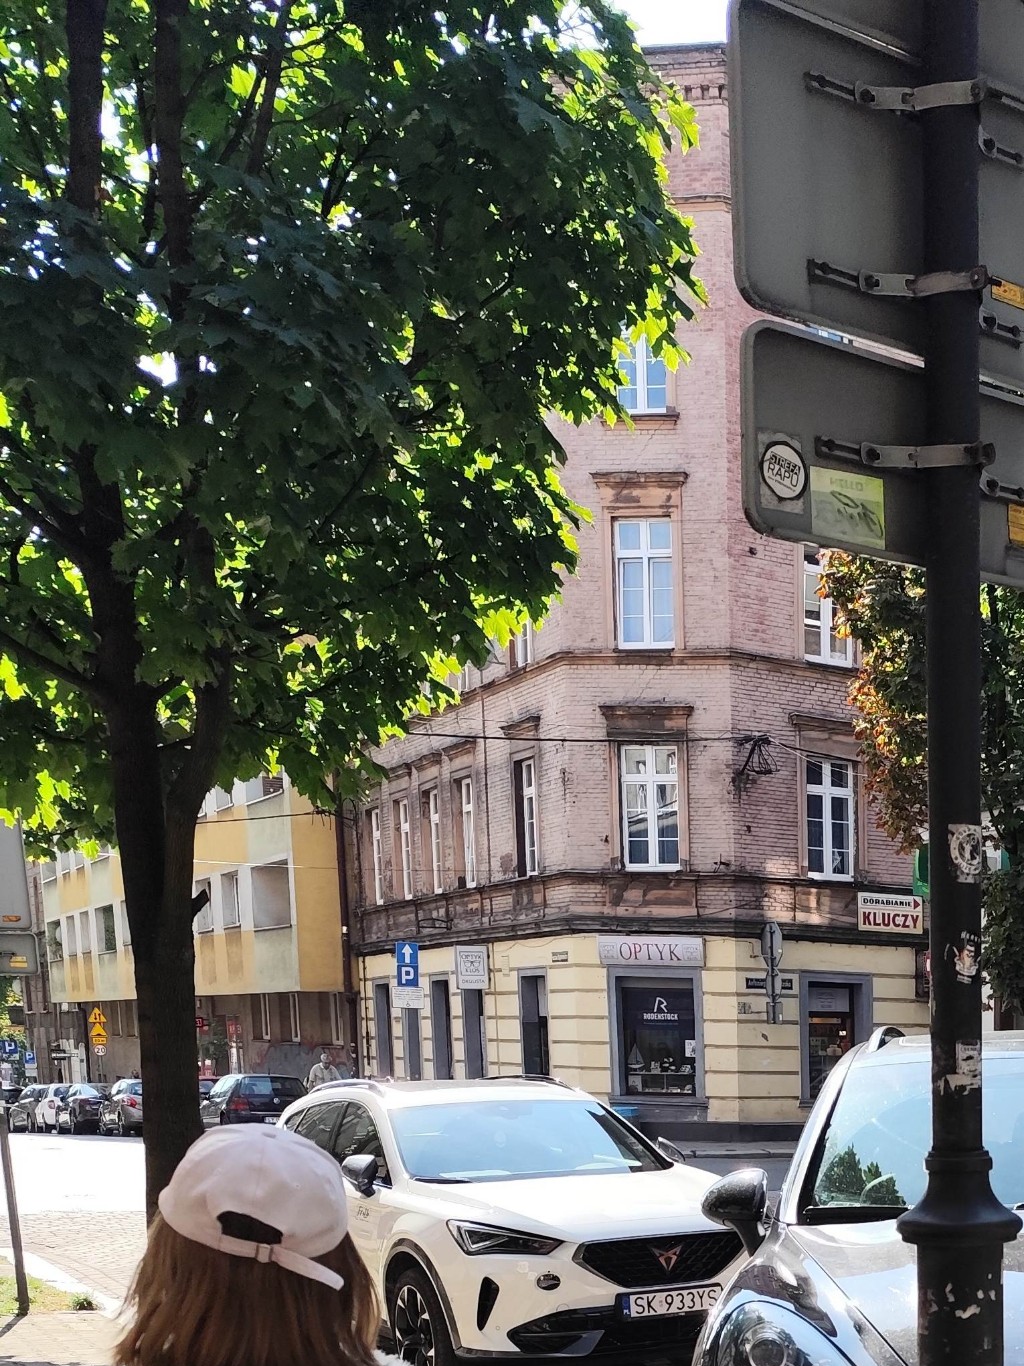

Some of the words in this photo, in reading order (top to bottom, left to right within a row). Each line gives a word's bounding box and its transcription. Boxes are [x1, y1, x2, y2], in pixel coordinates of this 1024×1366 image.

[770, 451, 801, 476] STREFA
[862, 898, 912, 907] DORABIANIE
[862, 911, 920, 929] KLUCZY
[619, 942, 682, 961] OPTYK
[401, 966, 414, 984] P
[634, 1294, 658, 1315] SK
[664, 1289, 718, 1312] 933YS
